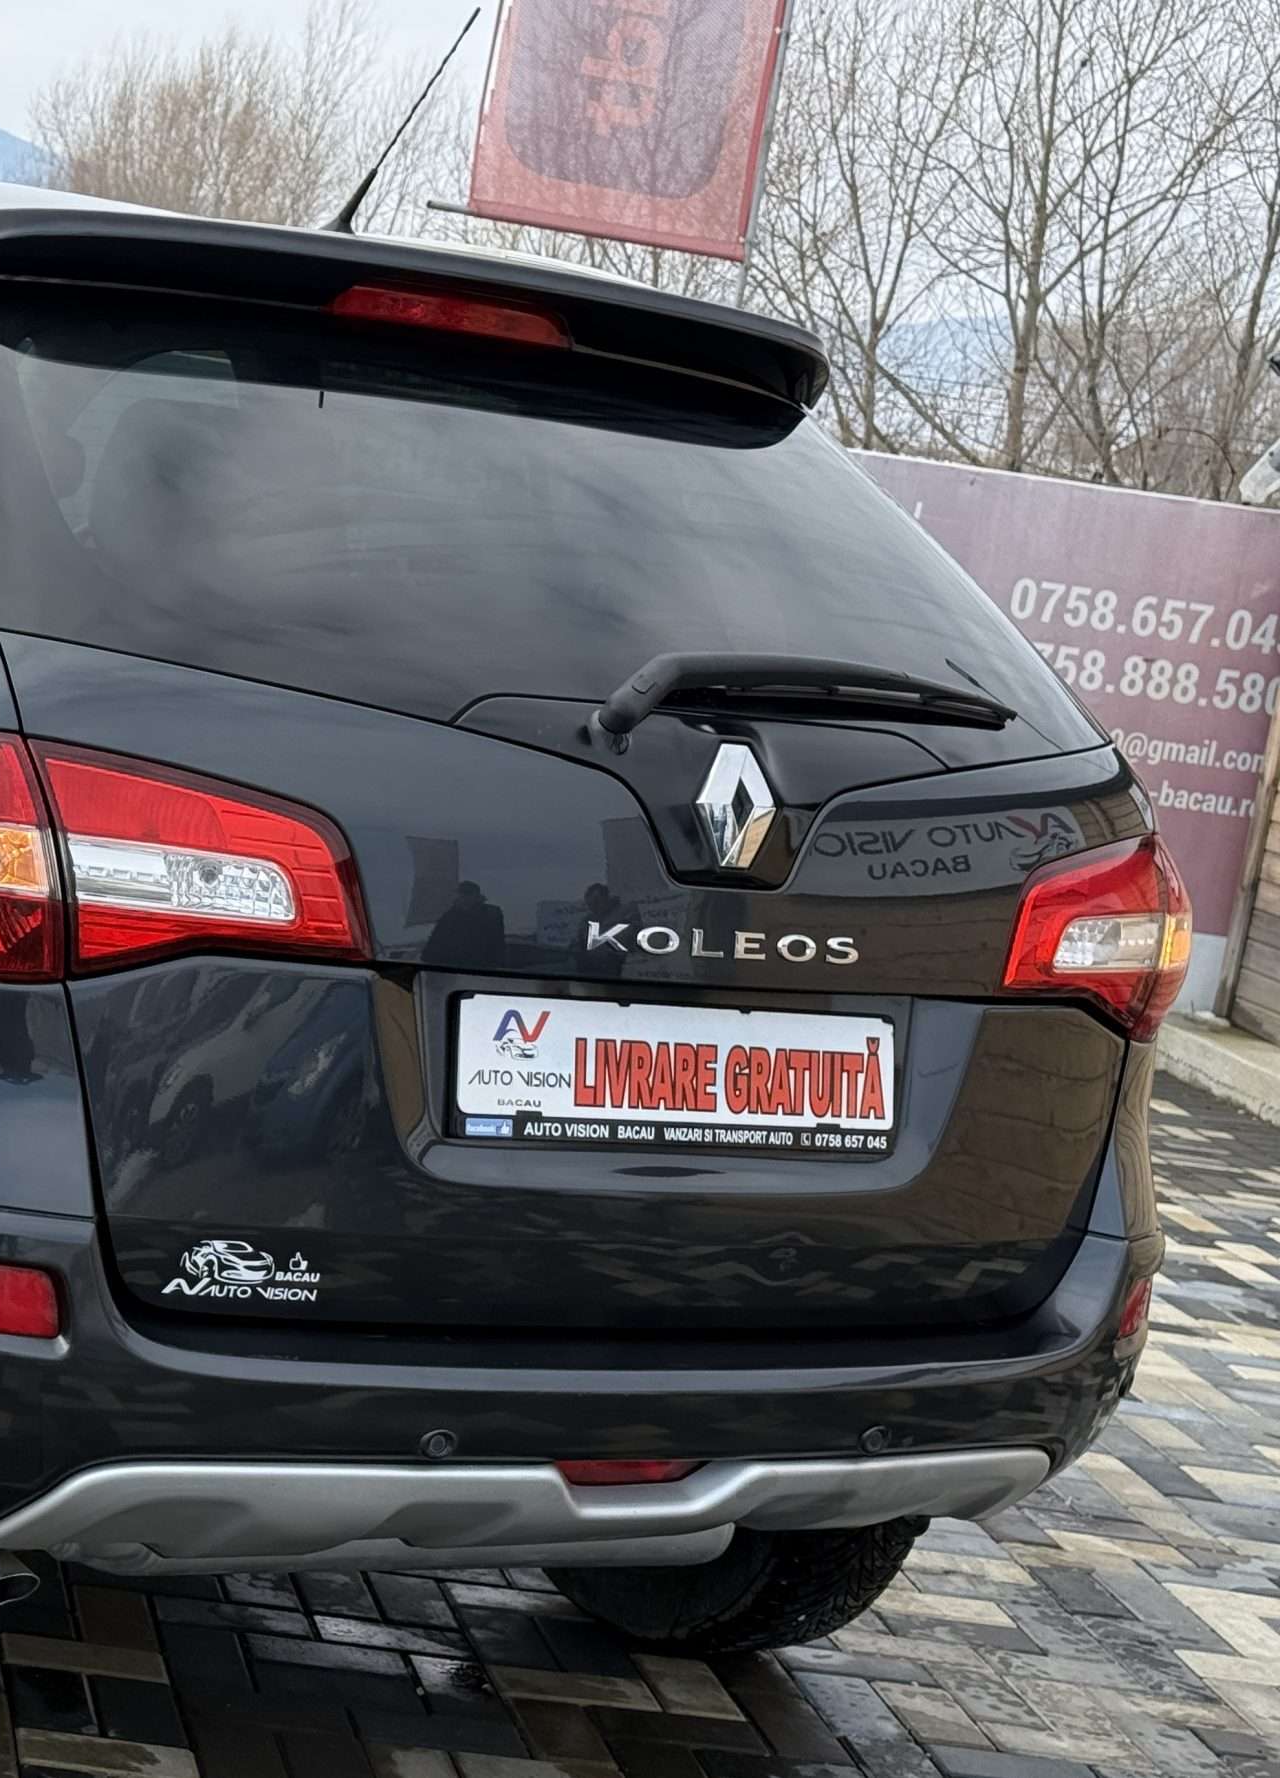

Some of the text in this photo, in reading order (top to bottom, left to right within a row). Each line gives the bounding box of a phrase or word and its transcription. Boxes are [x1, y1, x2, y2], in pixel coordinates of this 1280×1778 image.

[1010, 578, 1280, 655] 0758.657.04
[586, 920, 859, 964] KOLEOS
[468, 1069, 571, 1089] AUTO VISION
[574, 1036, 885, 1119] LIVRARE GRATUITĂ
[497, 1098, 542, 1108] BACAU
[524, 1122, 887, 1149] AUTO VISION BACAU VANZARI SI TRANSPORT AUTO 0758 657 045
[274, 1271, 320, 1283] BACAU
[198, 1286, 251, 1298] AUTO
[255, 1286, 318, 1302] VISION
